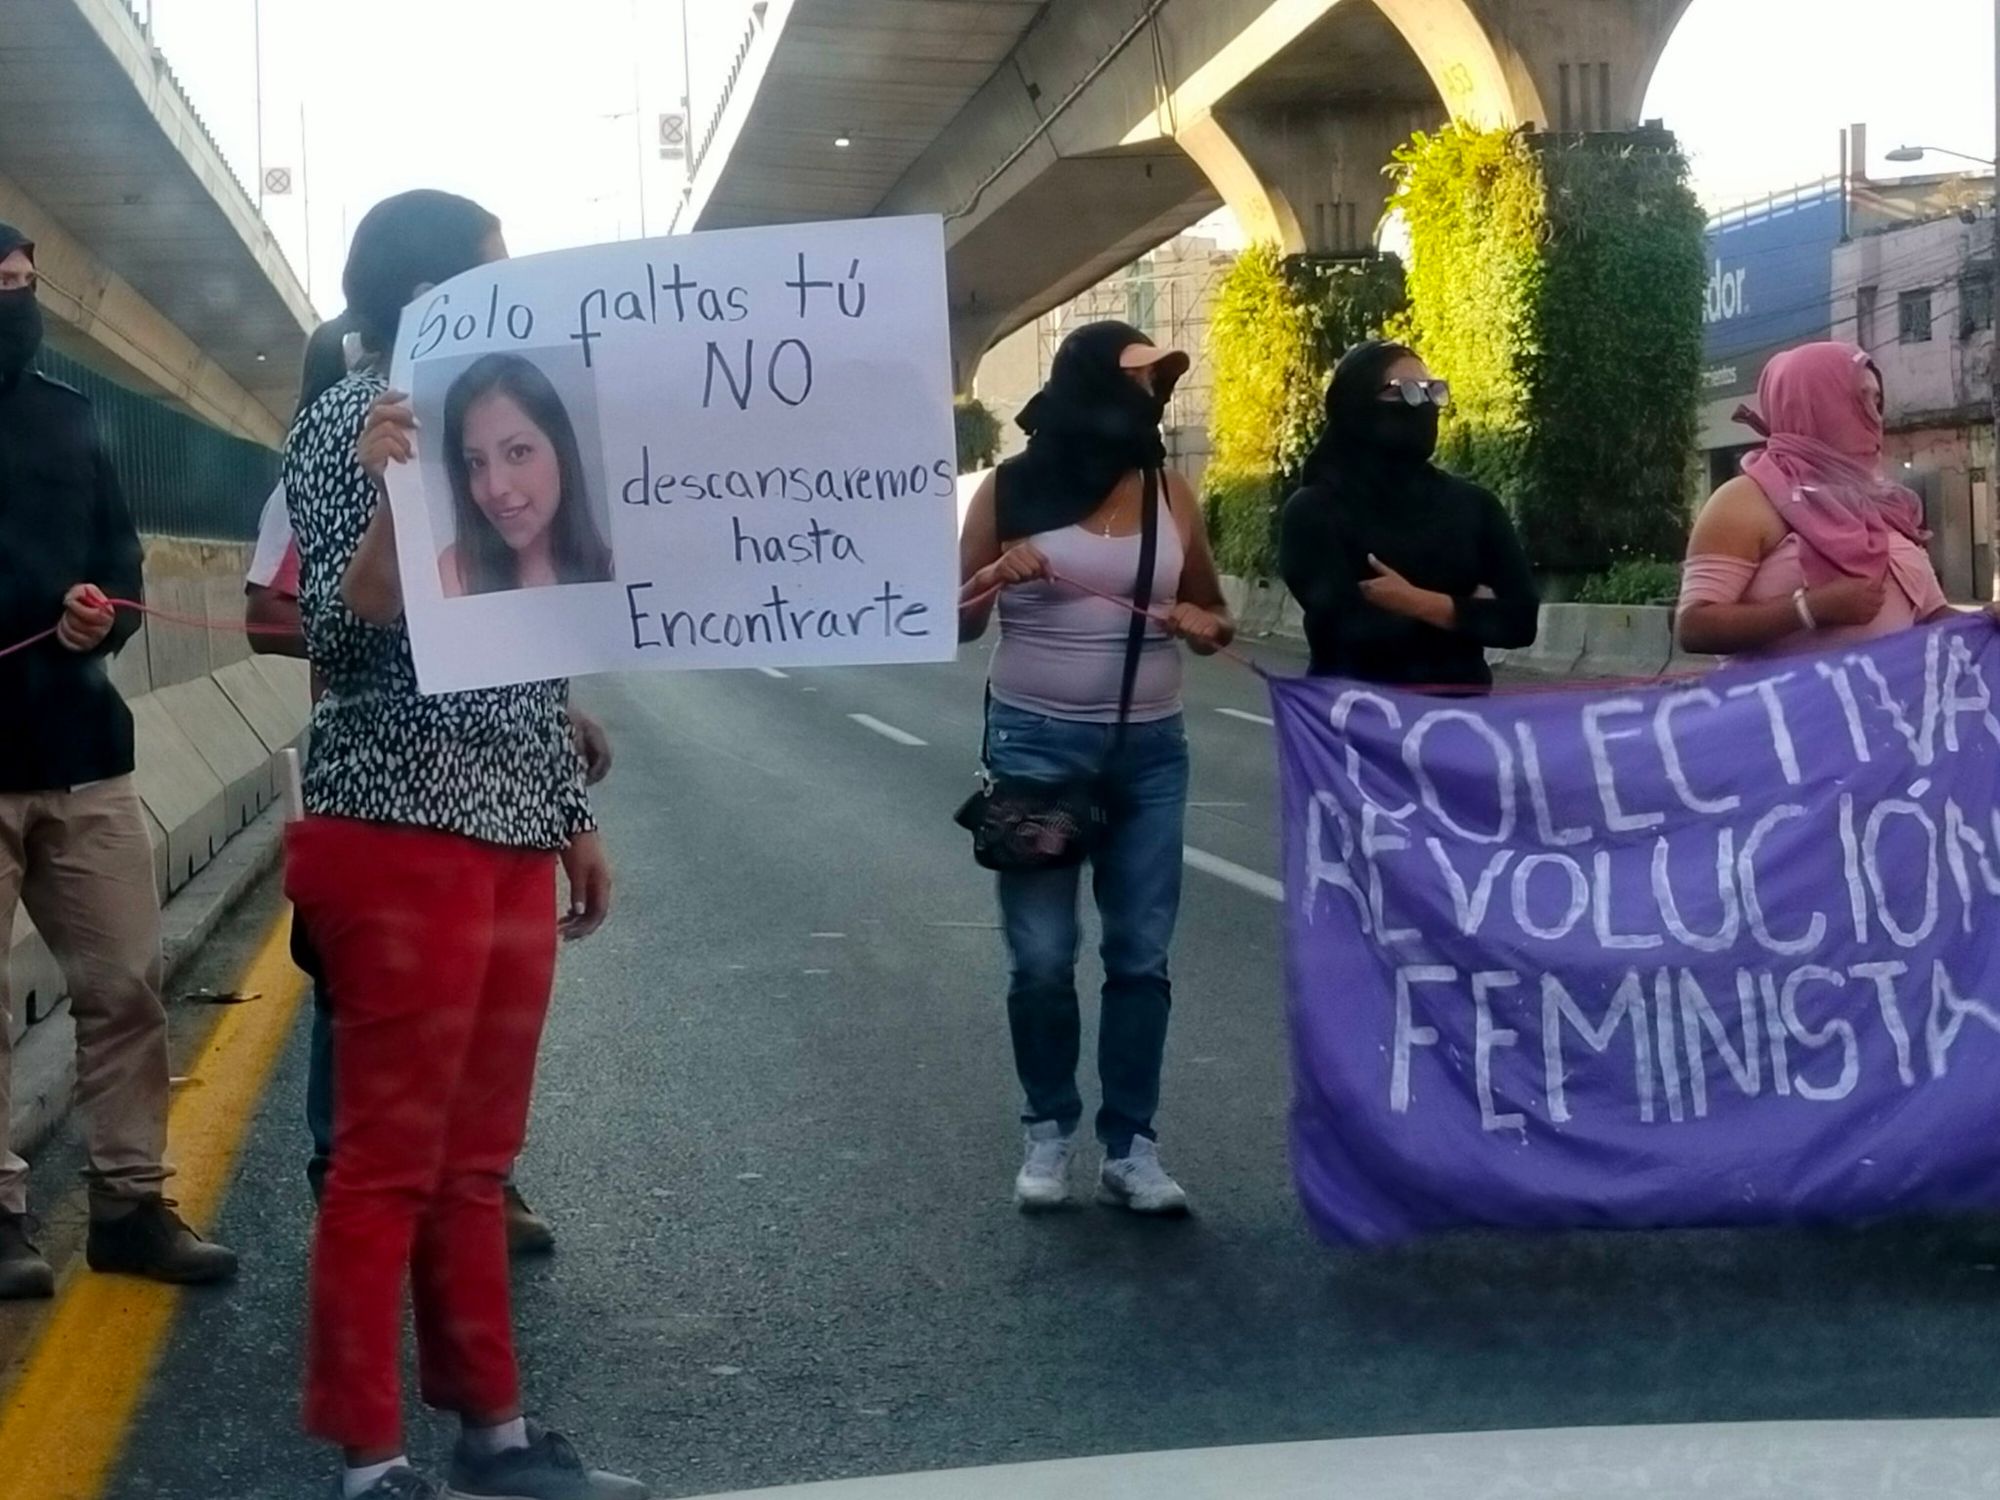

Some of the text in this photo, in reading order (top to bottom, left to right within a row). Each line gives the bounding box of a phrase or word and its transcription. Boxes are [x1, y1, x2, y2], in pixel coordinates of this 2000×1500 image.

[410, 252, 867, 368] Solo faltas tú
[702, 338, 813, 410] NO
[621, 446, 956, 506] descansaremos
[732, 516, 865, 565] hasta
[626, 580, 931, 649] Encontrarte
[1330, 627, 2000, 847] COLECTIVA
[1390, 959, 2000, 1131] FEMINISTA
